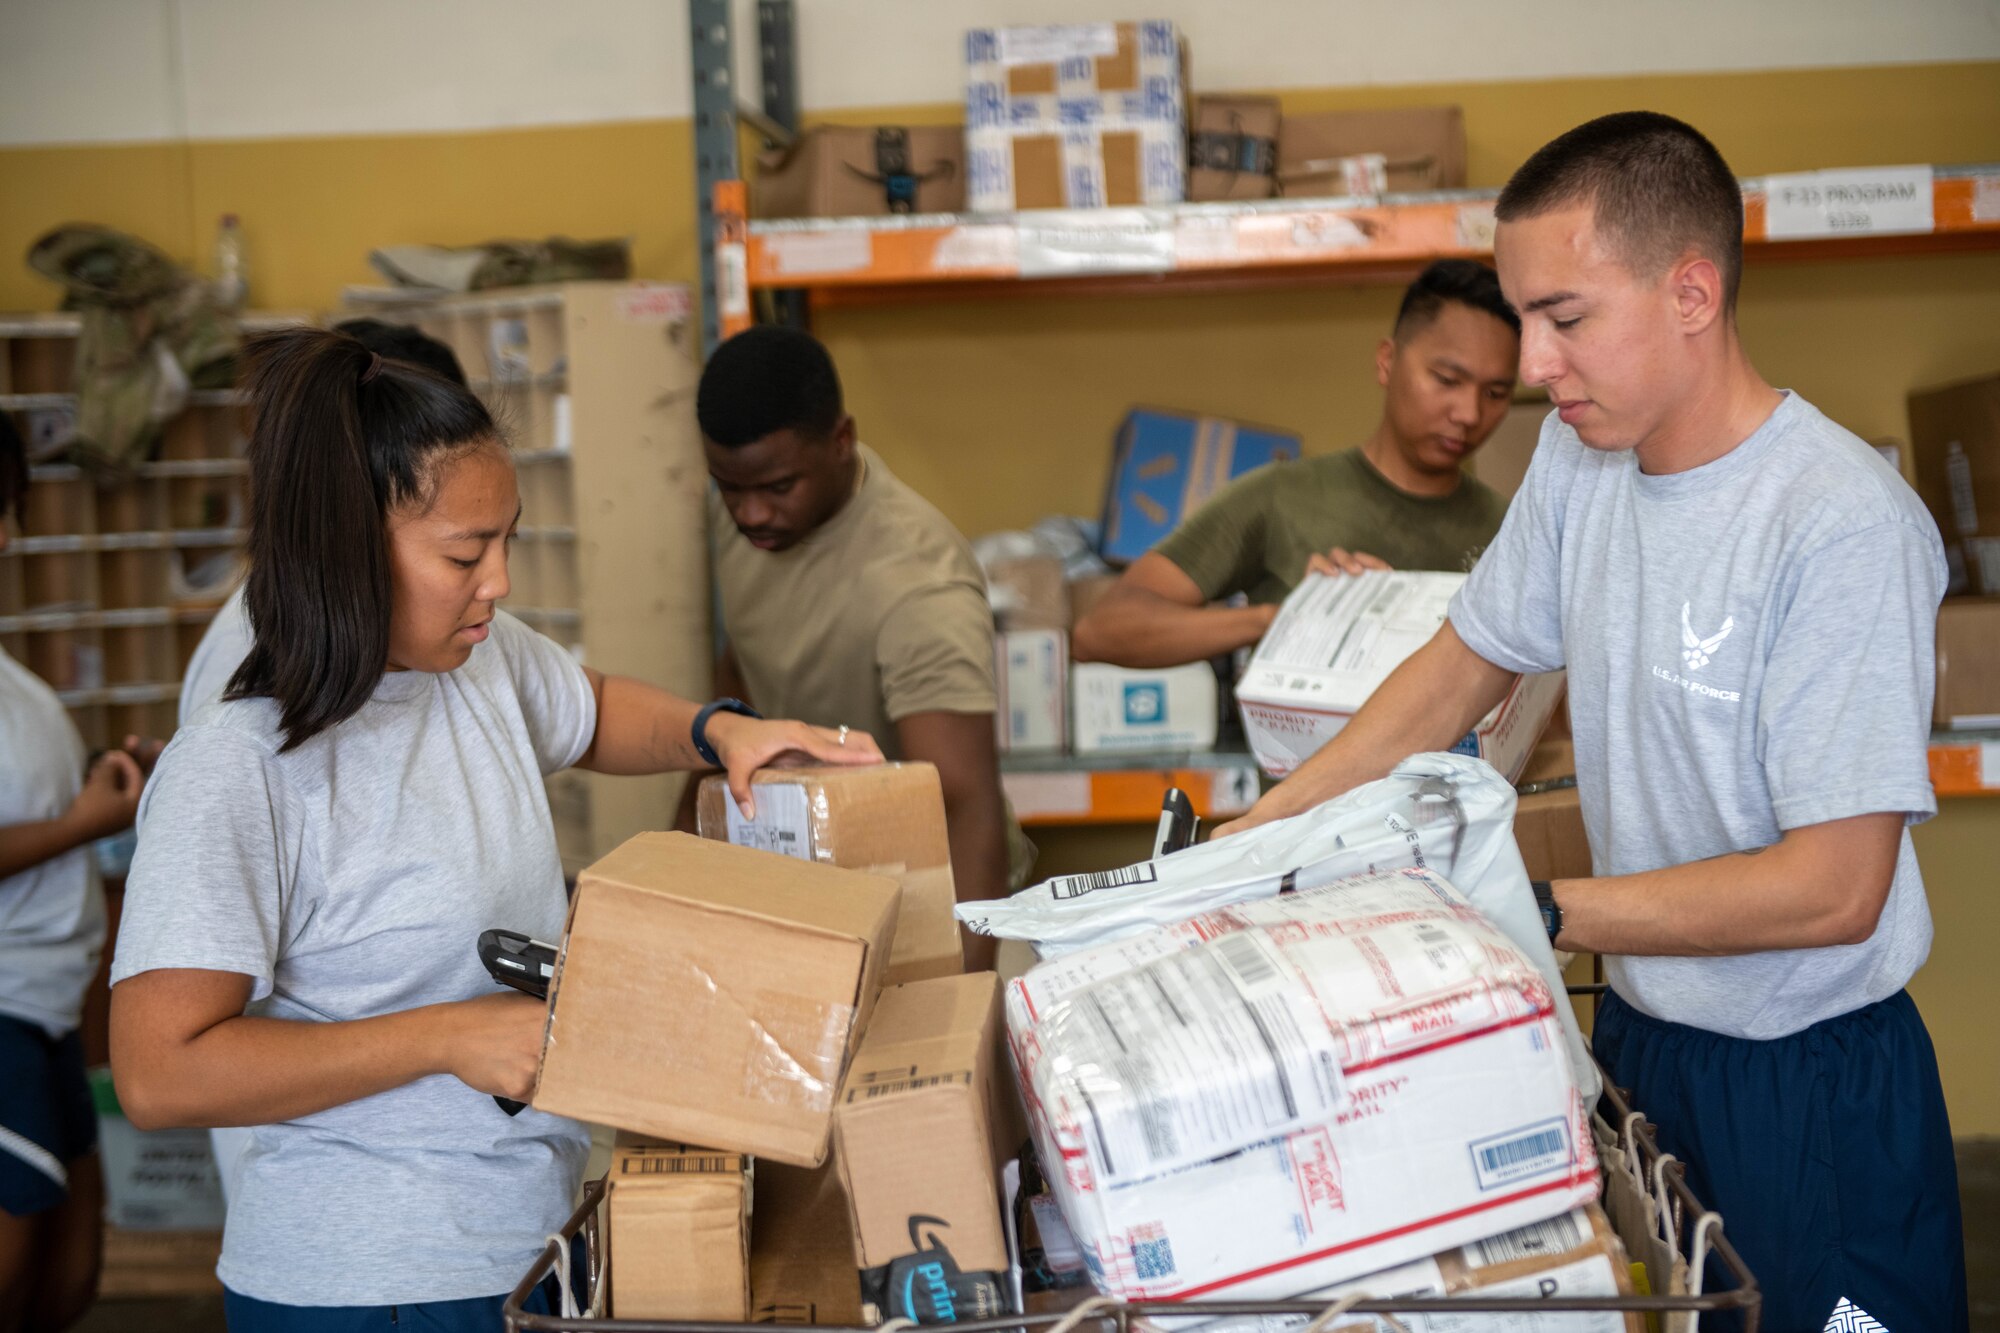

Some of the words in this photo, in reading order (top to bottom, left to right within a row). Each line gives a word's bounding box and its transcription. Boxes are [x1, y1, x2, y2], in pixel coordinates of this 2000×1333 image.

[1825, 182, 1917, 205] PROGRAM
[1689, 681, 1741, 702] FORCE
[1250, 709, 1317, 727] PRIORITY
[1386, 990, 1473, 1024] PRIORITY
[1411, 1013, 1459, 1034] MAIL
[1335, 1103, 1385, 1126] MAIL
